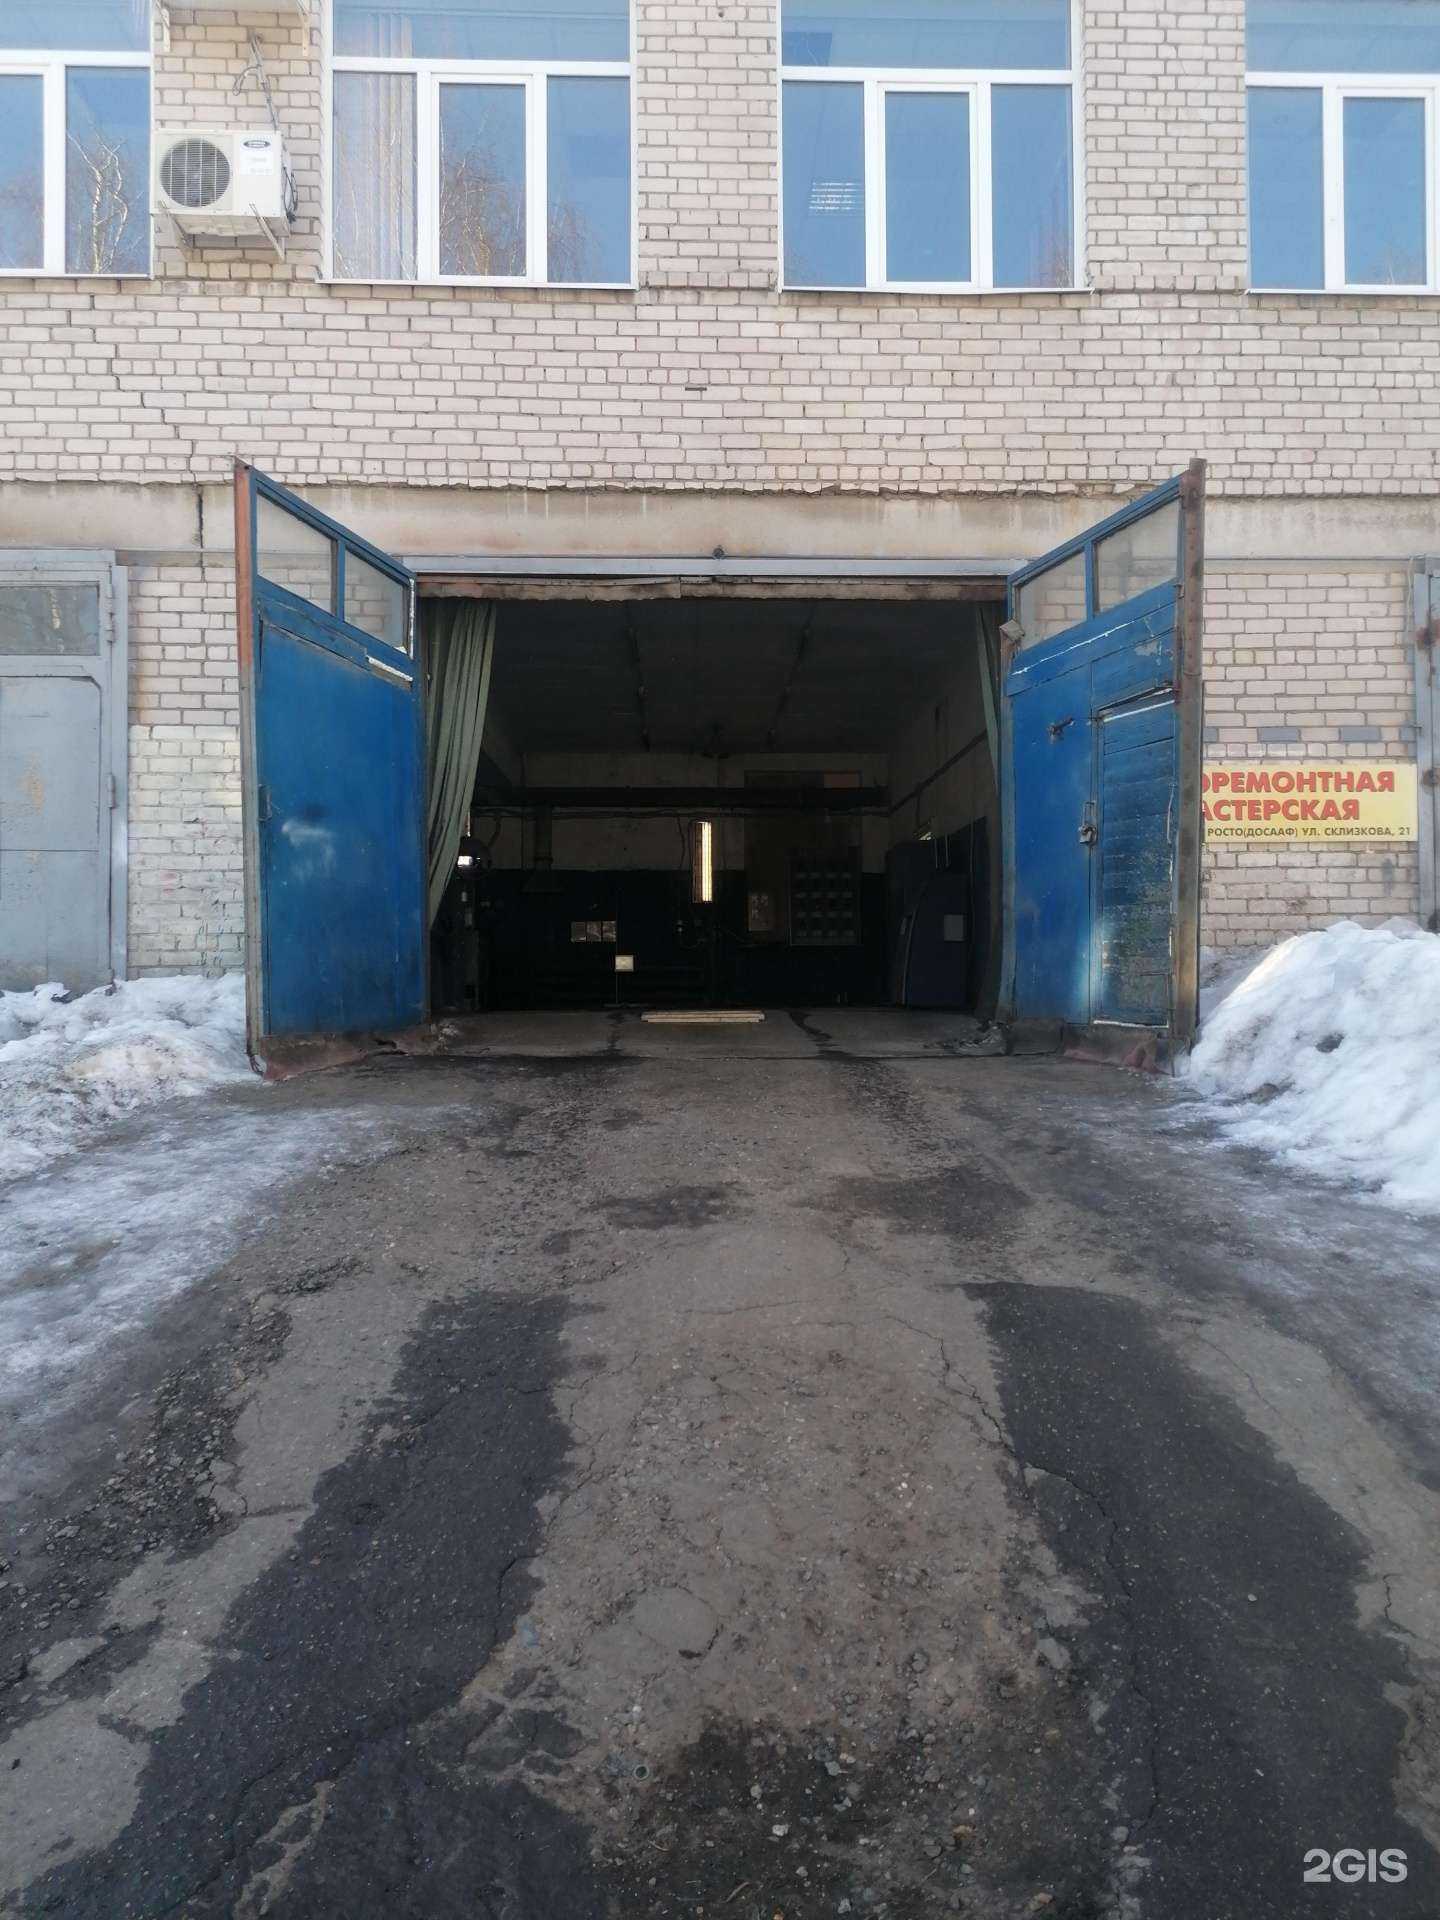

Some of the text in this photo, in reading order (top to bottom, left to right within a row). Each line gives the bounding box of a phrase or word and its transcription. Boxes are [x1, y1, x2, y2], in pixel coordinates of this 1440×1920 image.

[1207, 827, 1411, 838] РОСТО(ДОСААФ) УЛ. СКЛИЗКОВА, 21
